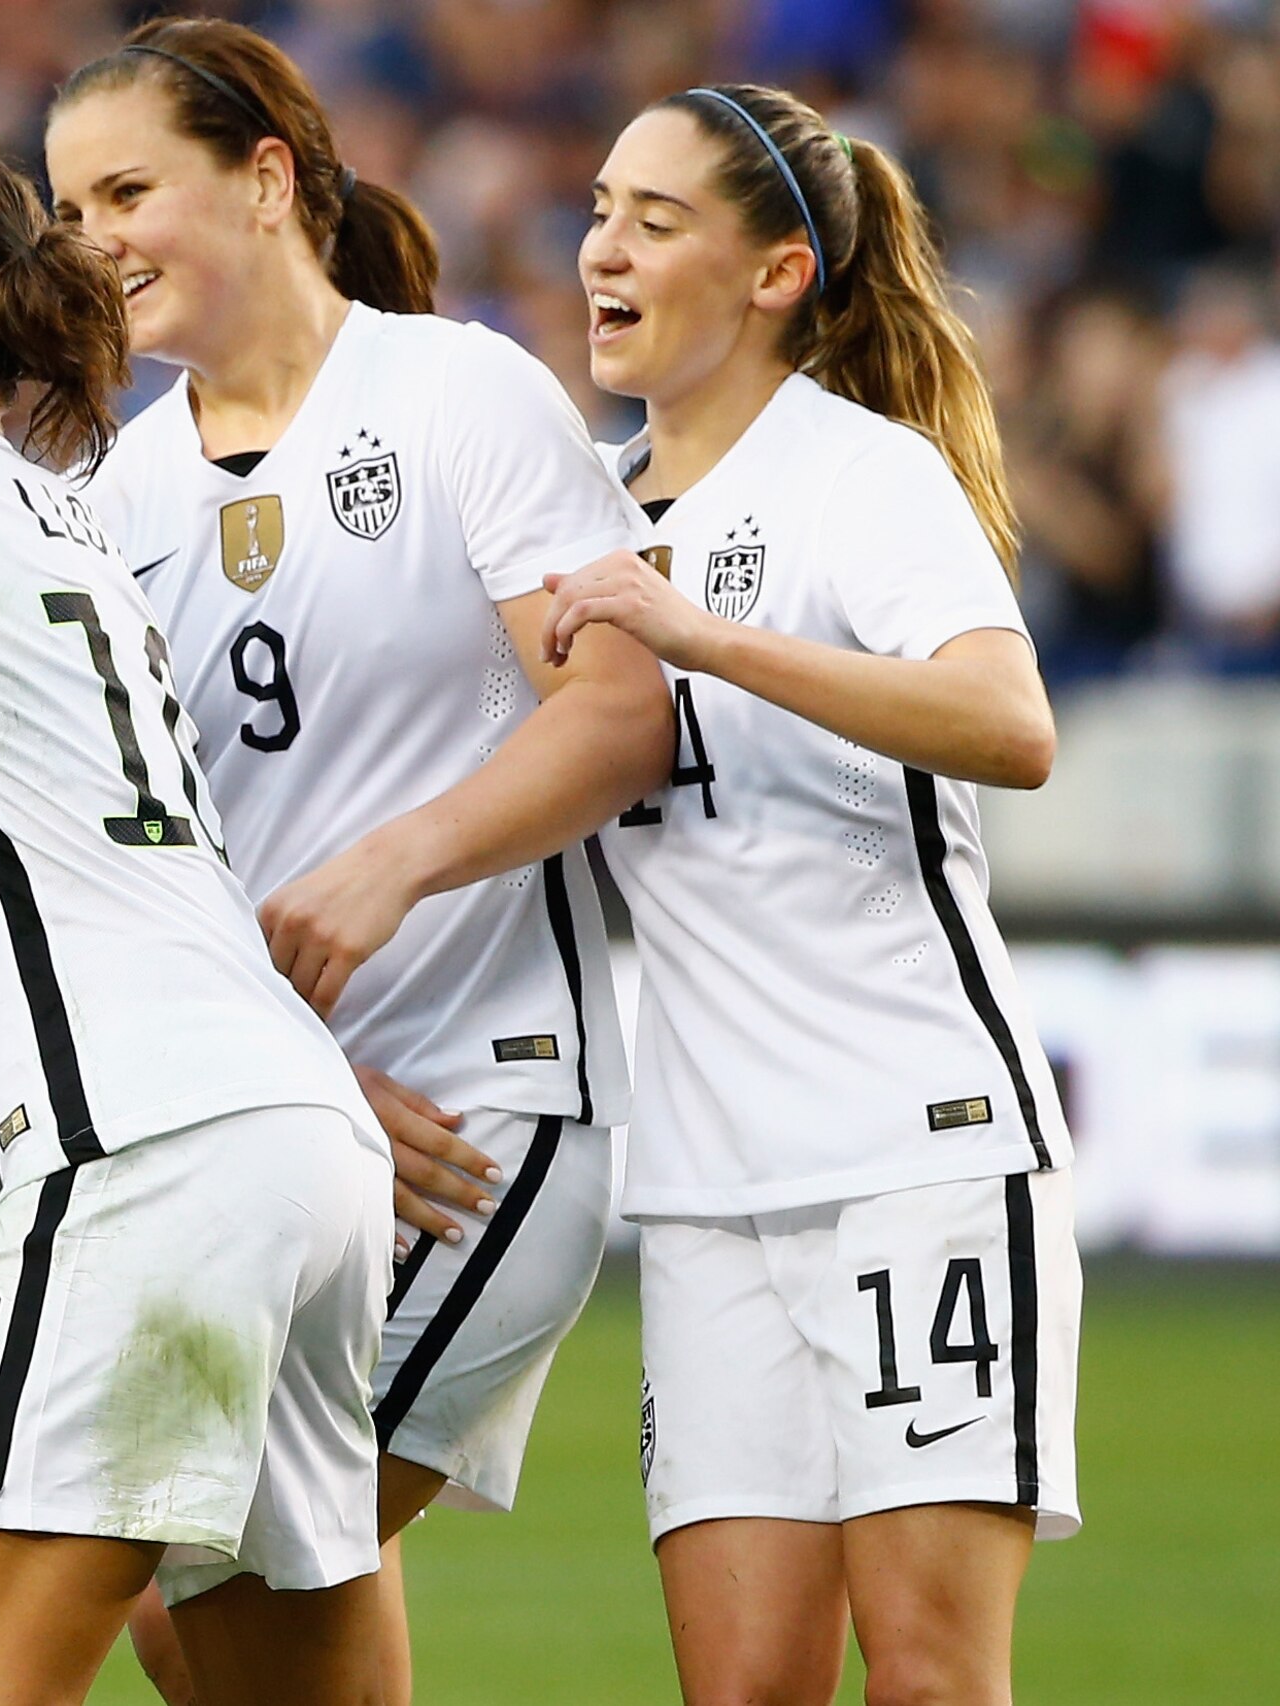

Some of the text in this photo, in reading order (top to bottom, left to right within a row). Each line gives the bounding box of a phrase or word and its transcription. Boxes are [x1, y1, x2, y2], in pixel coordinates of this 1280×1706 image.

[238, 554, 268, 573] FIFA
[230, 620, 300, 752] 9
[619, 678, 717, 827] 4
[857, 1258, 999, 1409] 14
